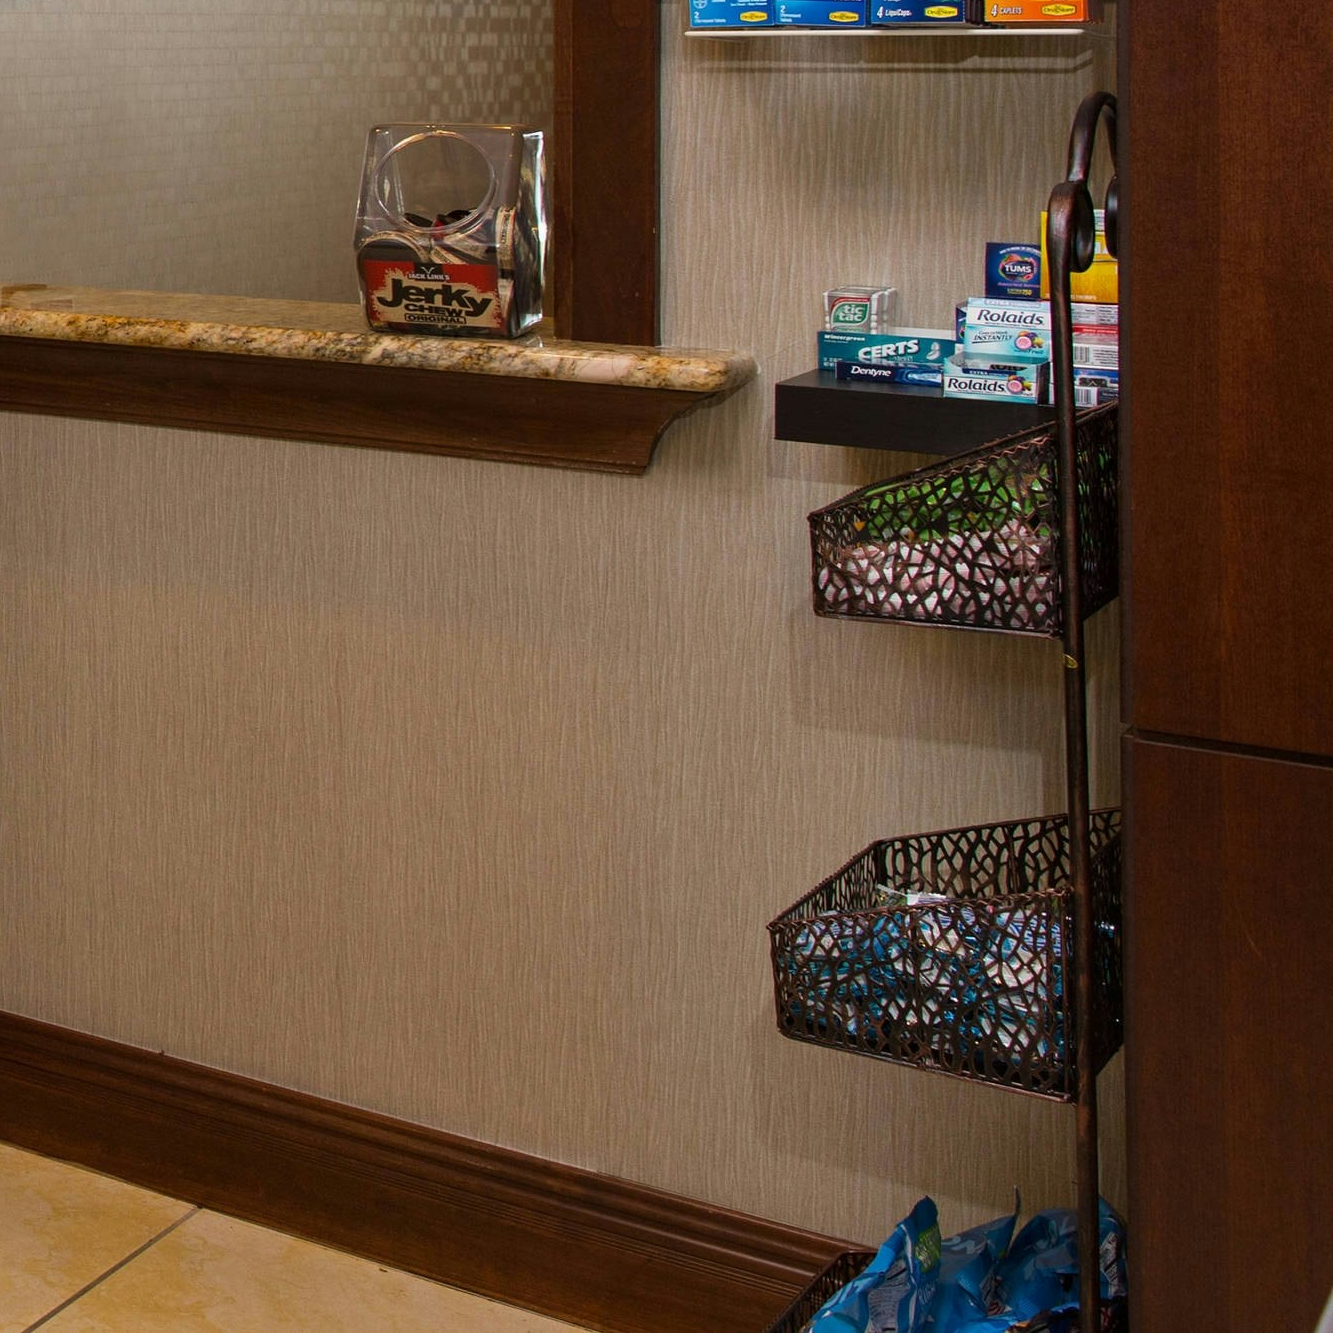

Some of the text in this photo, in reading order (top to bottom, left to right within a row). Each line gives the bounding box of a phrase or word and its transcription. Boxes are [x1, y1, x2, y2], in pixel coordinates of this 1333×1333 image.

[780, 5, 785, 14] 2
[877, 6, 883, 18] 4
[991, 4, 1022, 17] 4 CAPLETS
[694, 11, 699, 20] 2
[1004, 264, 1033, 274] TUMS
[408, 271, 451, 282] JACK LINK'S
[377, 278, 493, 317] Jerky
[405, 303, 464, 317] CHEW
[843, 304, 864, 315] tic
[407, 315, 465, 325] ORIGINAL
[839, 313, 863, 322] tac
[977, 309, 1044, 325] Rolaids
[973, 334, 1013, 342] INSTANTLY
[858, 339, 920, 360] CERTS
[851, 365, 892, 377] Dentyne
[947, 377, 1006, 394] Rolaids
